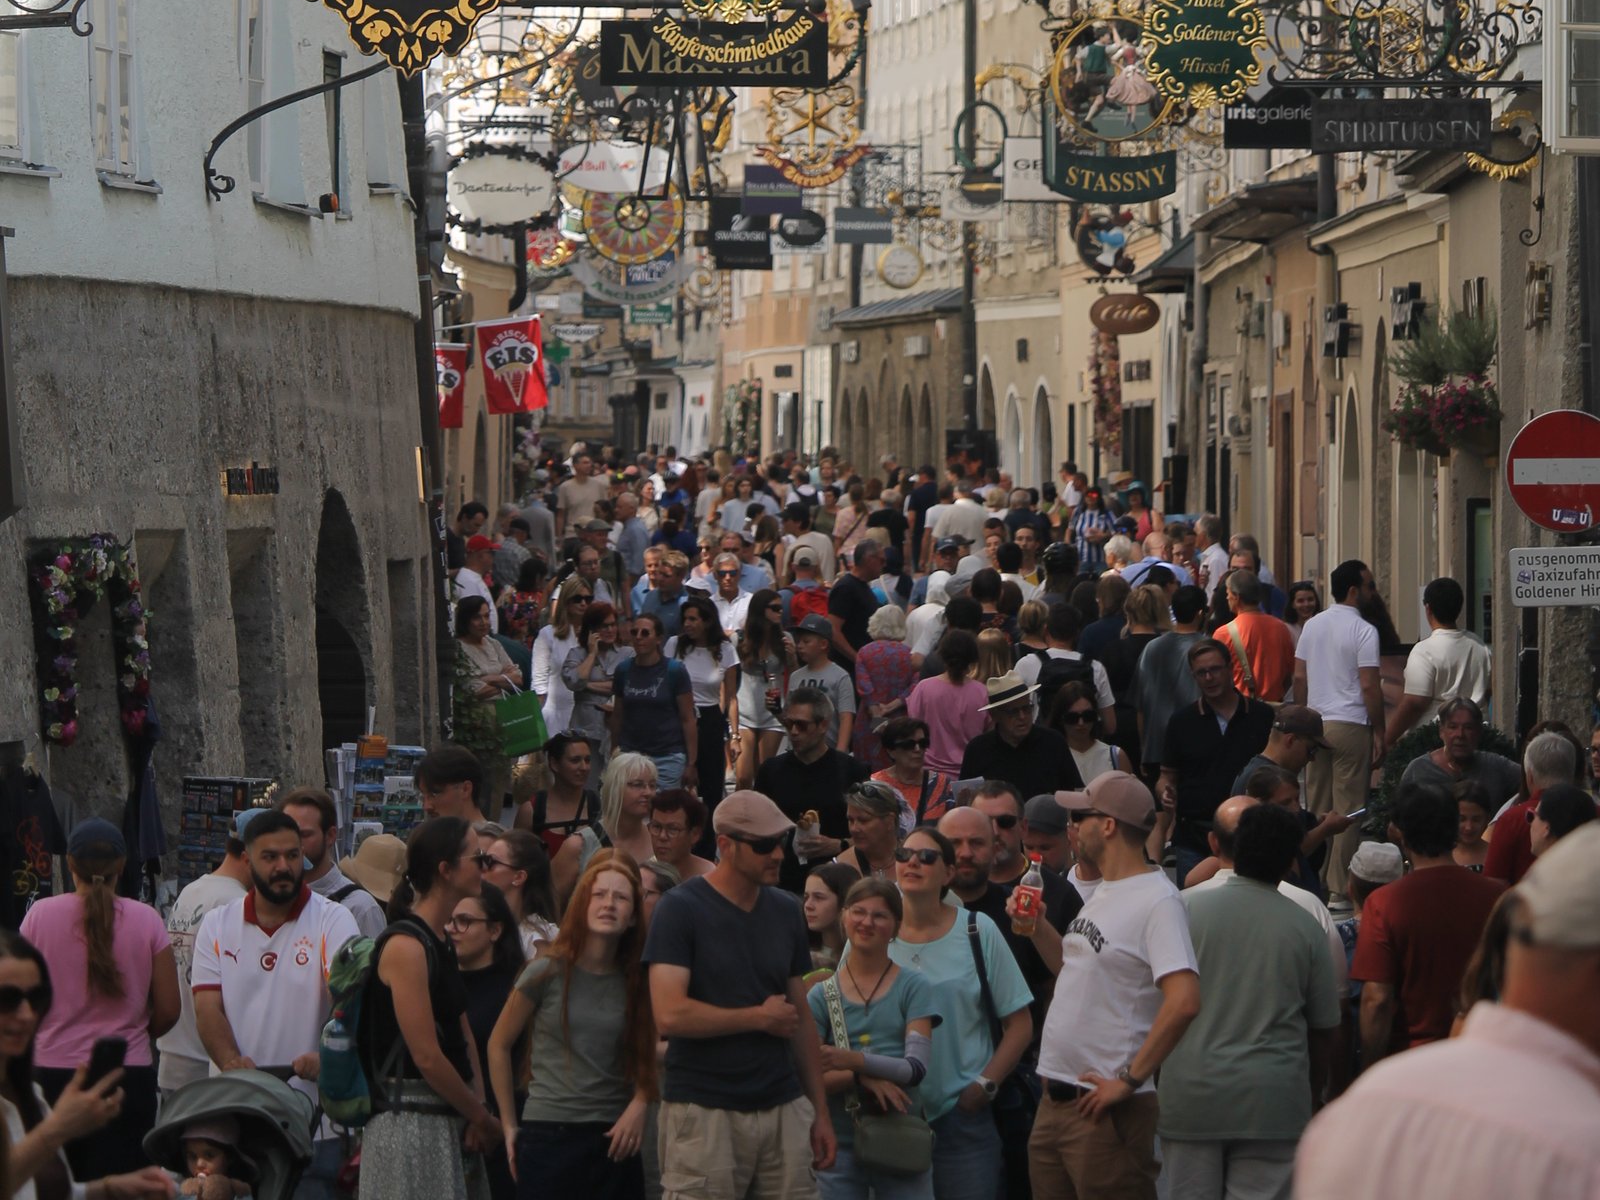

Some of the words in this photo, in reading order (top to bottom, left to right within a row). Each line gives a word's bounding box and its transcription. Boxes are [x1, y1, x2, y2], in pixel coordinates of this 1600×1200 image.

[653, 15, 814, 64] Kupferschmiedhaus
[1172, 22, 1240, 43] Goldener
[1179, 56, 1231, 75] Hirsch
[1227, 102, 1311, 125] irisgalerie
[1324, 119, 1481, 144] SPIRITUOSEN
[1064, 164, 1167, 193] STASSNY
[491, 329, 529, 347] FRISCH
[487, 346, 536, 371] EIS
[1515, 585, 1576, 599] Goldener
